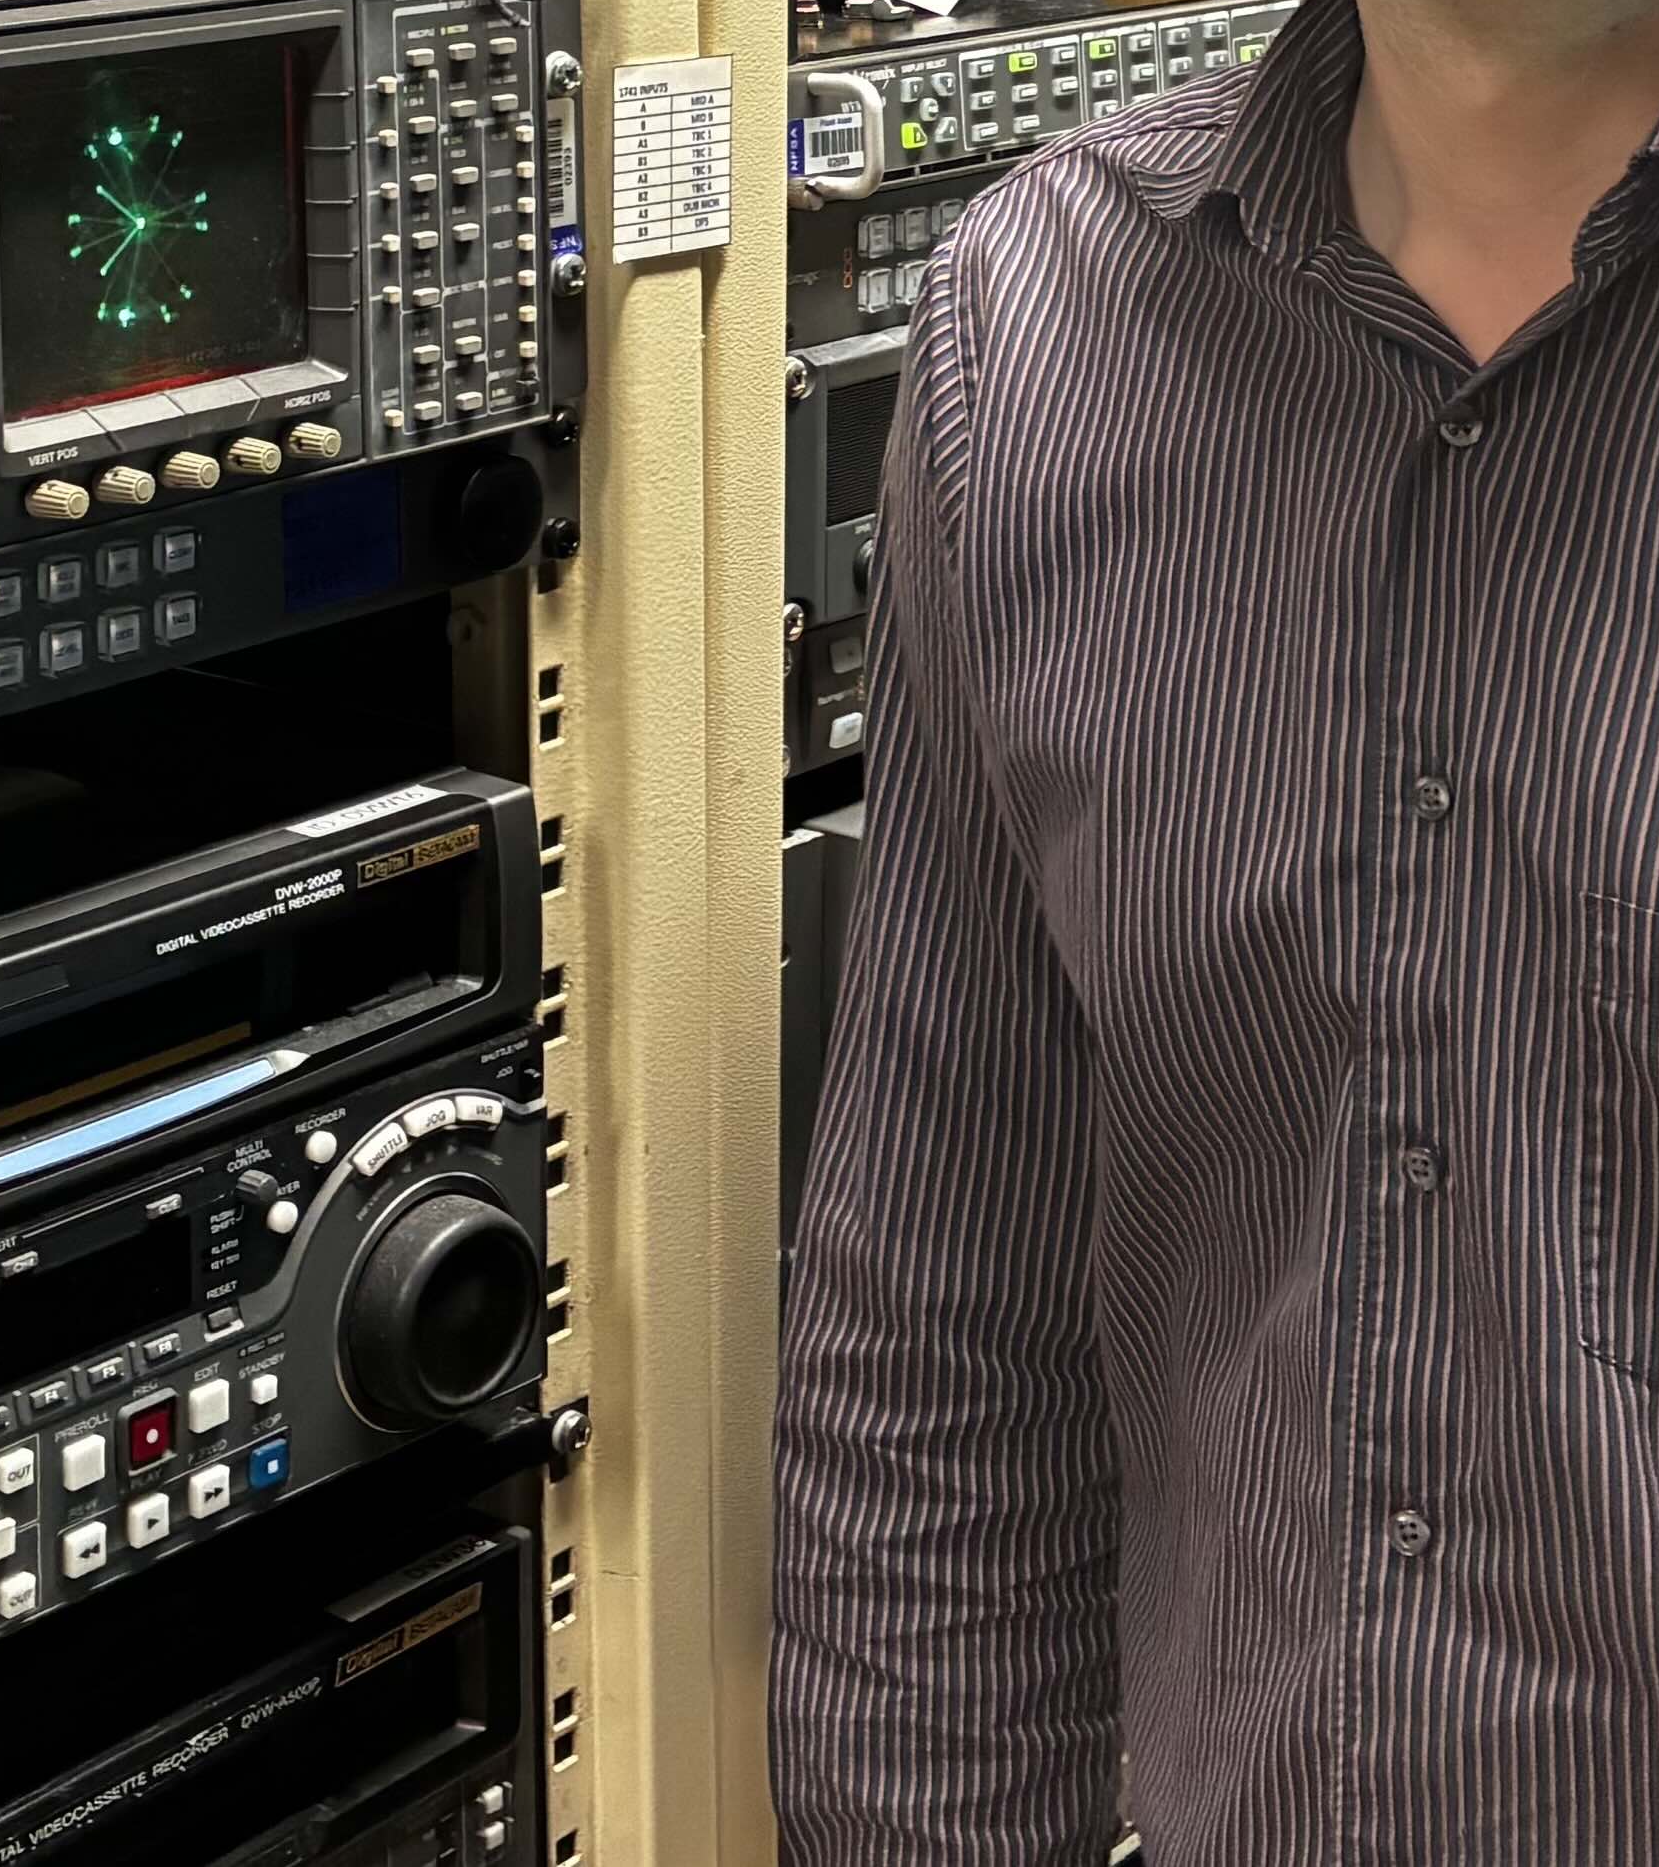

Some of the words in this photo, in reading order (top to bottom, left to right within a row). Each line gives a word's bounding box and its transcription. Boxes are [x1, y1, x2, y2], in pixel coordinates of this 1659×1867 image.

[640, 102, 647, 114] A
[28, 449, 56, 467] VERT
[57, 445, 79, 463] POS
[363, 851, 409, 880] Digital
[274, 868, 344, 902] DVW-2000P
[155, 933, 199, 957] DIGITAL
[200, 902, 287, 942] VIDEOCASSETTE
[288, 882, 346, 912] RECORDER
[295, 1107, 347, 1135] RECORDER
[426, 1109, 447, 1128] JOG
[206, 1280, 238, 1300] RESET
[193, 1362, 221, 1382] EDIT
[238, 1352, 286, 1380] STANDBY
[44, 1389, 60, 1403] F4
[252, 1413, 283, 1435] STOP
[7, 1464, 32, 1483] OUT
[9, 1589, 32, 1607] OUT
[27, 1770, 148, 1847] VIDEOCASSETTE
[151, 1726, 229, 1779] RECORDER
